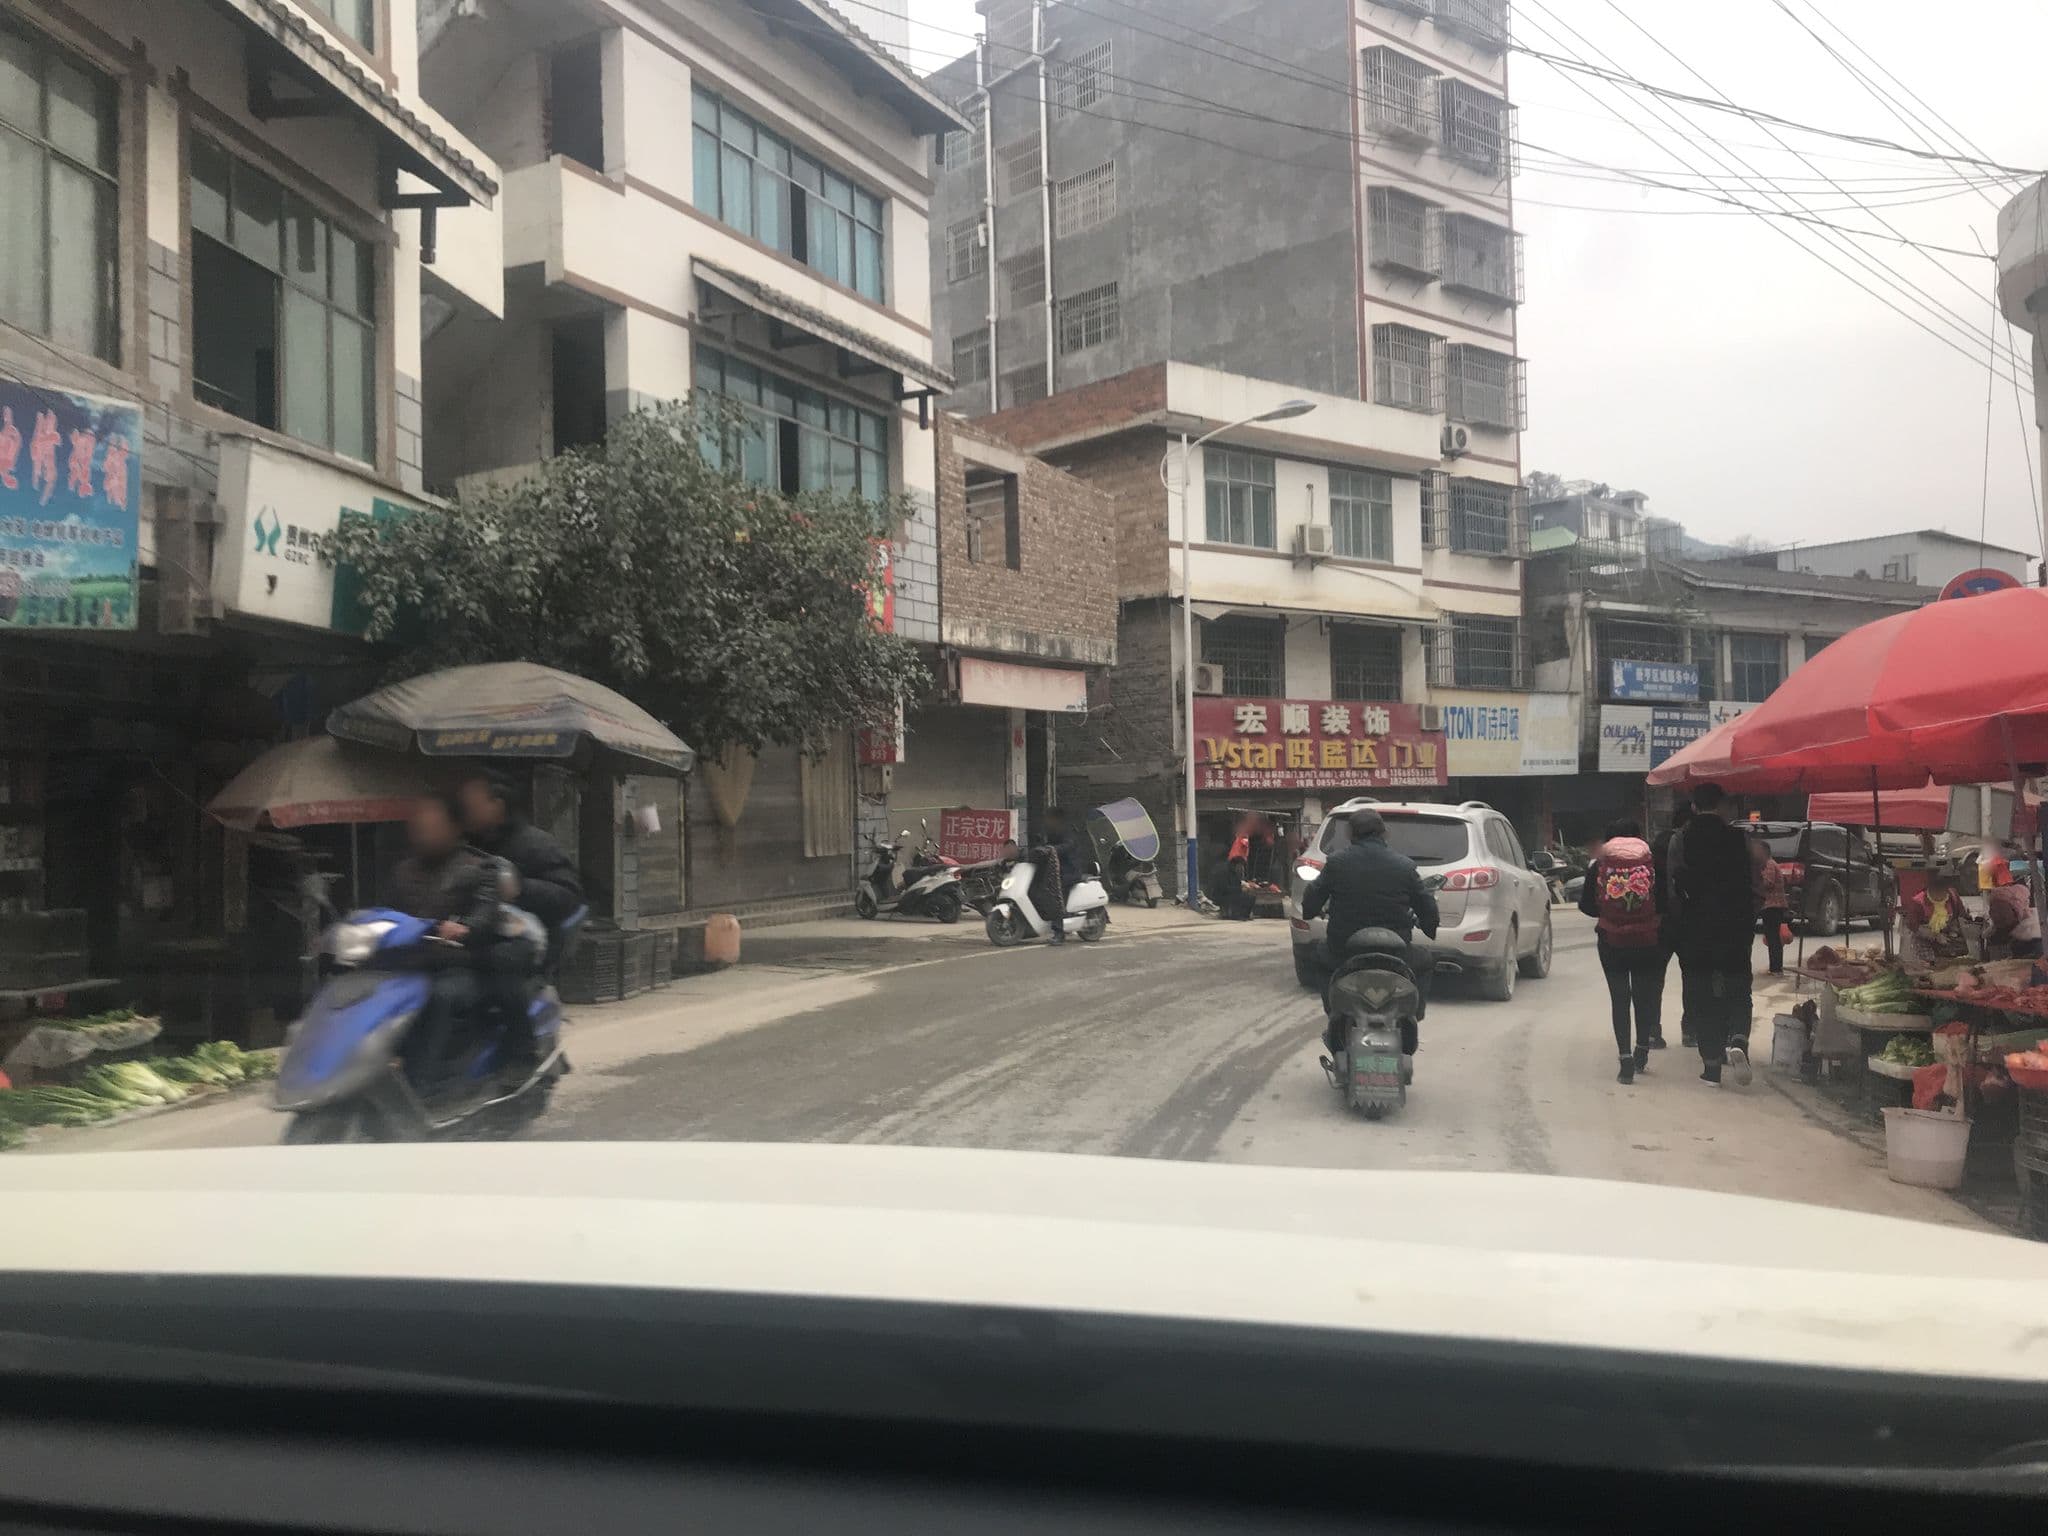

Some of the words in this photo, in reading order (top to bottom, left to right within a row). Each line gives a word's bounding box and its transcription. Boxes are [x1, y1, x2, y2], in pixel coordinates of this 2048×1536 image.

[1234, 703, 1390, 735] 宏顺装饰
[945, 815, 1005, 839] 正宗安龙
